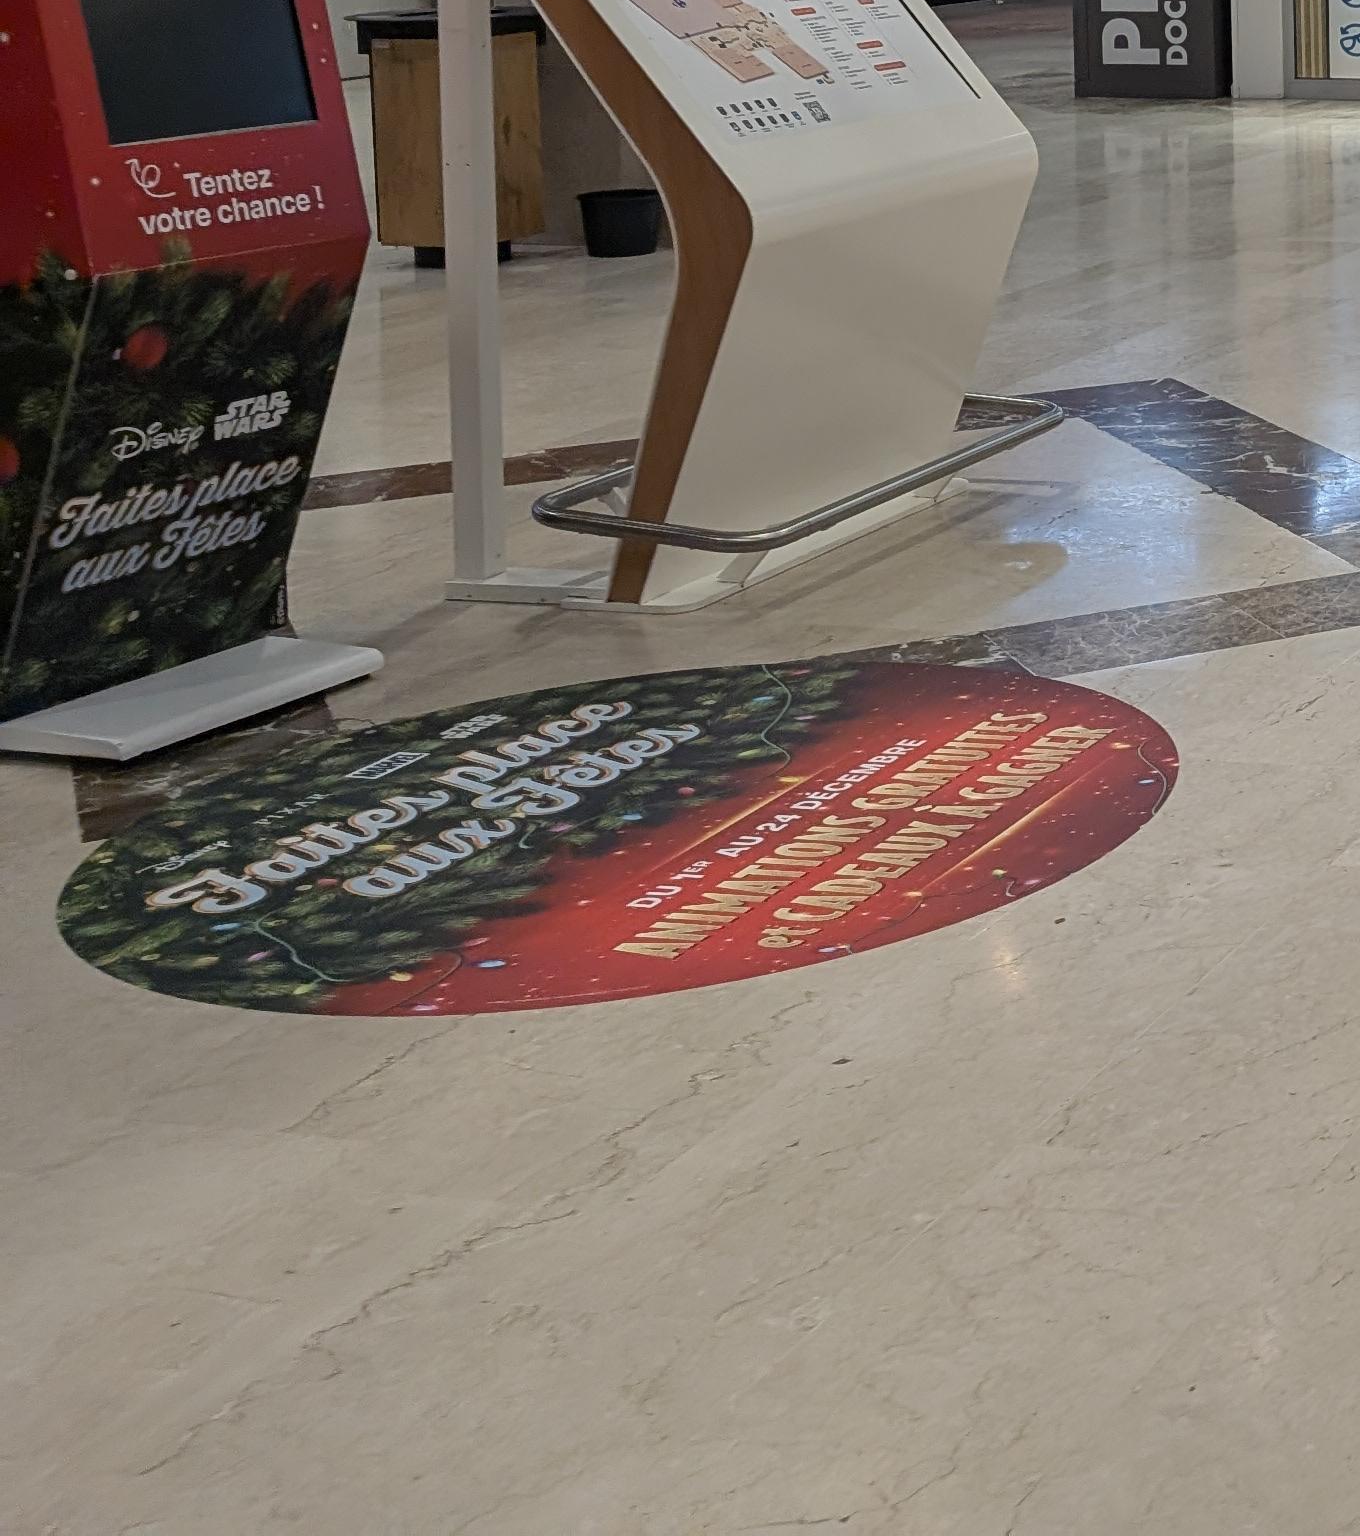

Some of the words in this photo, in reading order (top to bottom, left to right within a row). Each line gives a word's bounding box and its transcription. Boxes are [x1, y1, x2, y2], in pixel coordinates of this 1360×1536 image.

[138, 207, 212, 235] votre
[217, 193, 311, 224] chance
[312, 185, 325, 209] !
[183, 169, 273, 198] Tentez
[213, 408, 288, 441] WARS
[224, 390, 291, 422] STAR
[49, 480, 190, 547] Faites
[183, 455, 301, 522] place
[60, 542, 151, 594] aux
[152, 507, 269, 571] Fêtes
[959, 725, 1117, 800] GAGNER
[145, 789, 450, 914] Faites
[432, 700, 634, 796] place
[343, 817, 519, 898] aux
[470, 722, 702, 815] Fêtes
[612, 814, 888, 960] ANIMATIONS
[852, 711, 1050, 811] GRATUITES
[626, 885, 683, 909] DU
[670, 859, 715, 880] 1ER
[715, 835, 765, 859] AU
[756, 814, 801, 832] 24
[802, 737, 928, 812] DÉCEMBRE
[913, 804, 1004, 820] À
[773, 820, 975, 923] CADEAUX
[757, 925, 822, 949] et
